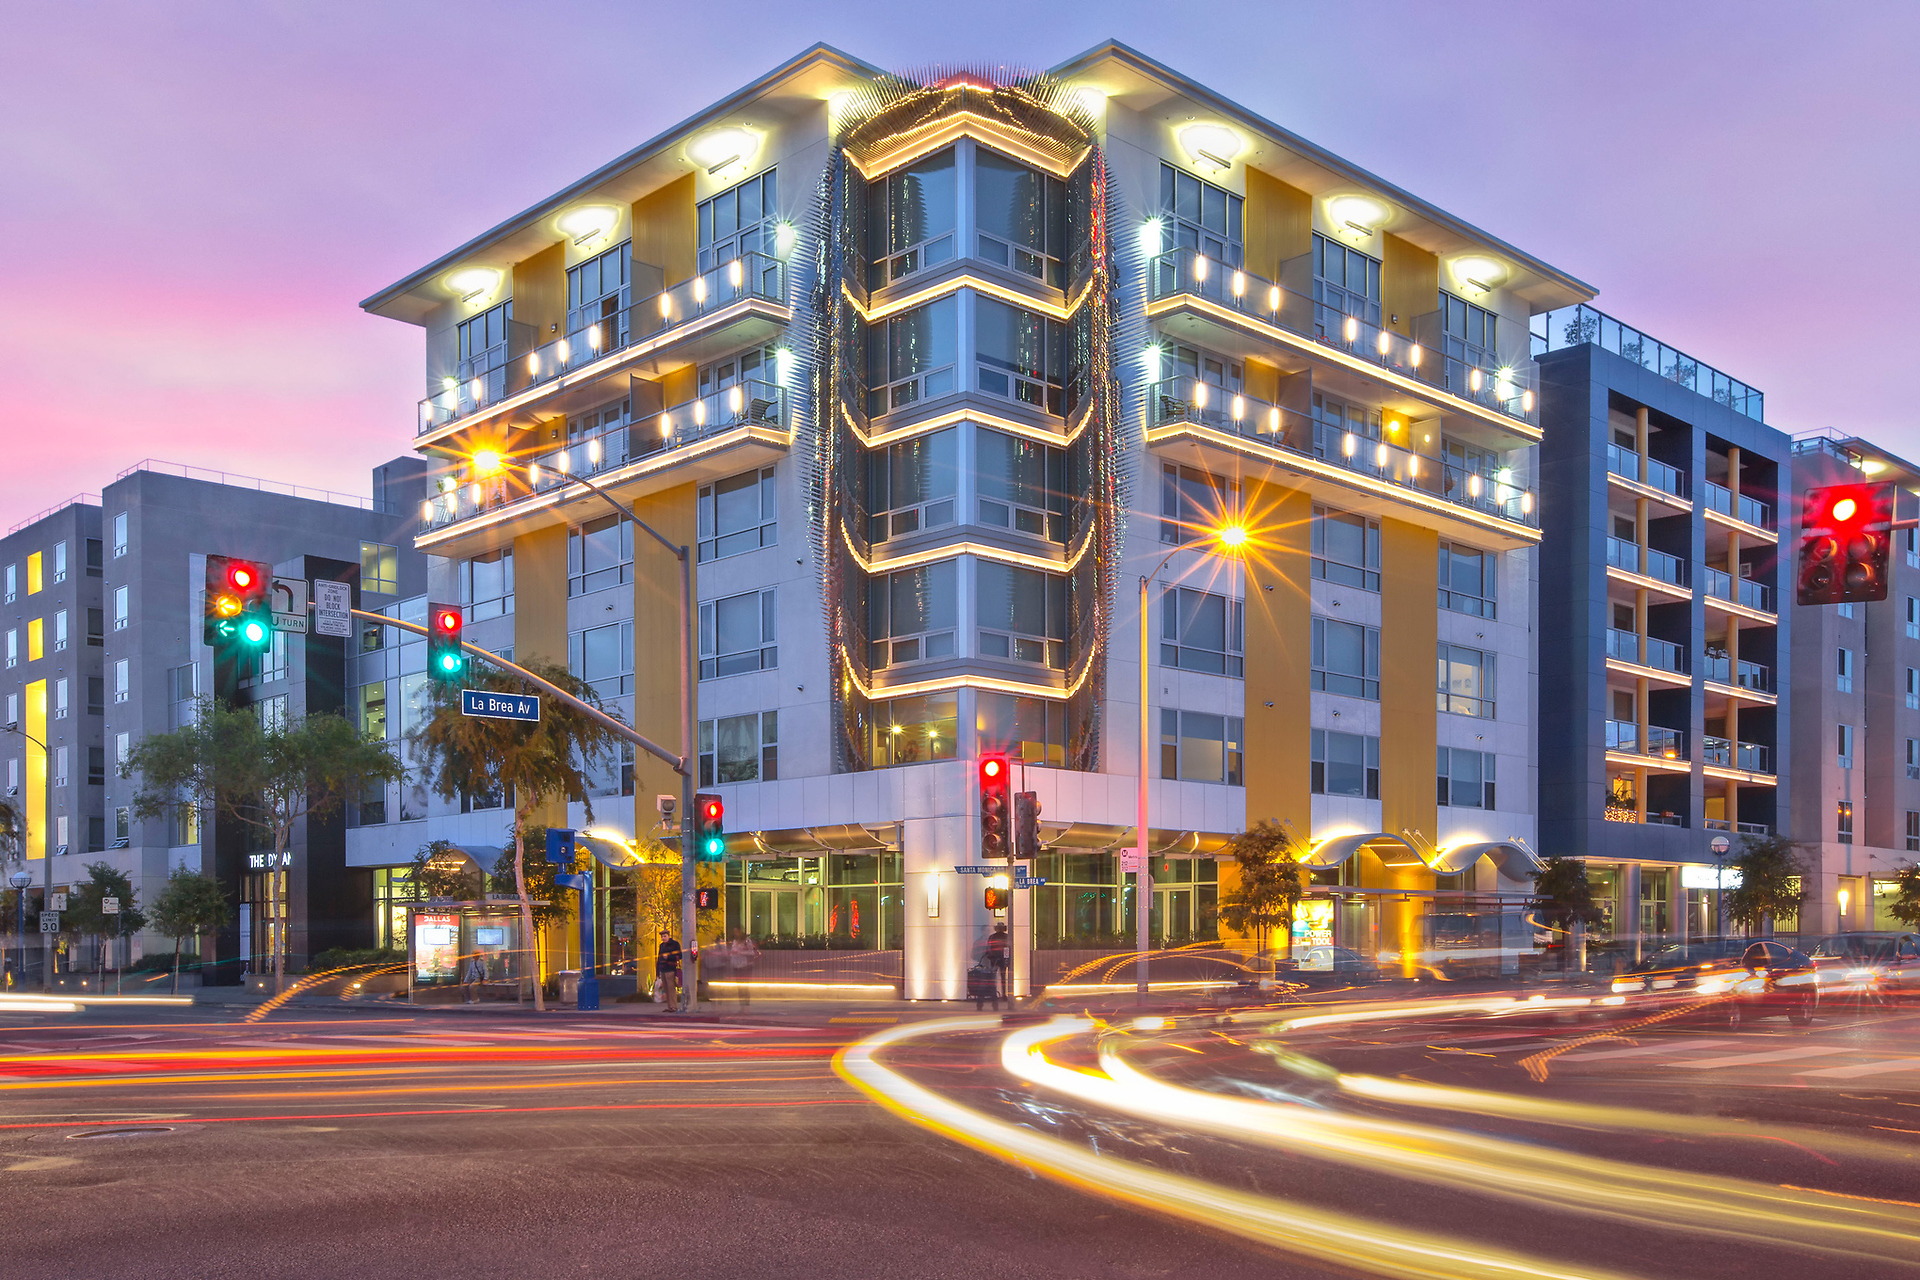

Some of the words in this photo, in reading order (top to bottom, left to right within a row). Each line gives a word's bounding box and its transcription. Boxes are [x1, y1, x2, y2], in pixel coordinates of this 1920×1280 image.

[324, 593, 331, 601] DO
[333, 595, 342, 603] NOT
[326, 601, 341, 610] BLOCK
[318, 609, 349, 619] INTERSECTION
[283, 618, 304, 628] TURN
[472, 697, 484, 710] La
[489, 698, 513, 713] Brea
[518, 701, 530, 714] Av
[249, 854, 265, 868] THE
[42, 922, 57, 931] 30
[1304, 929, 1332, 937] POWER
